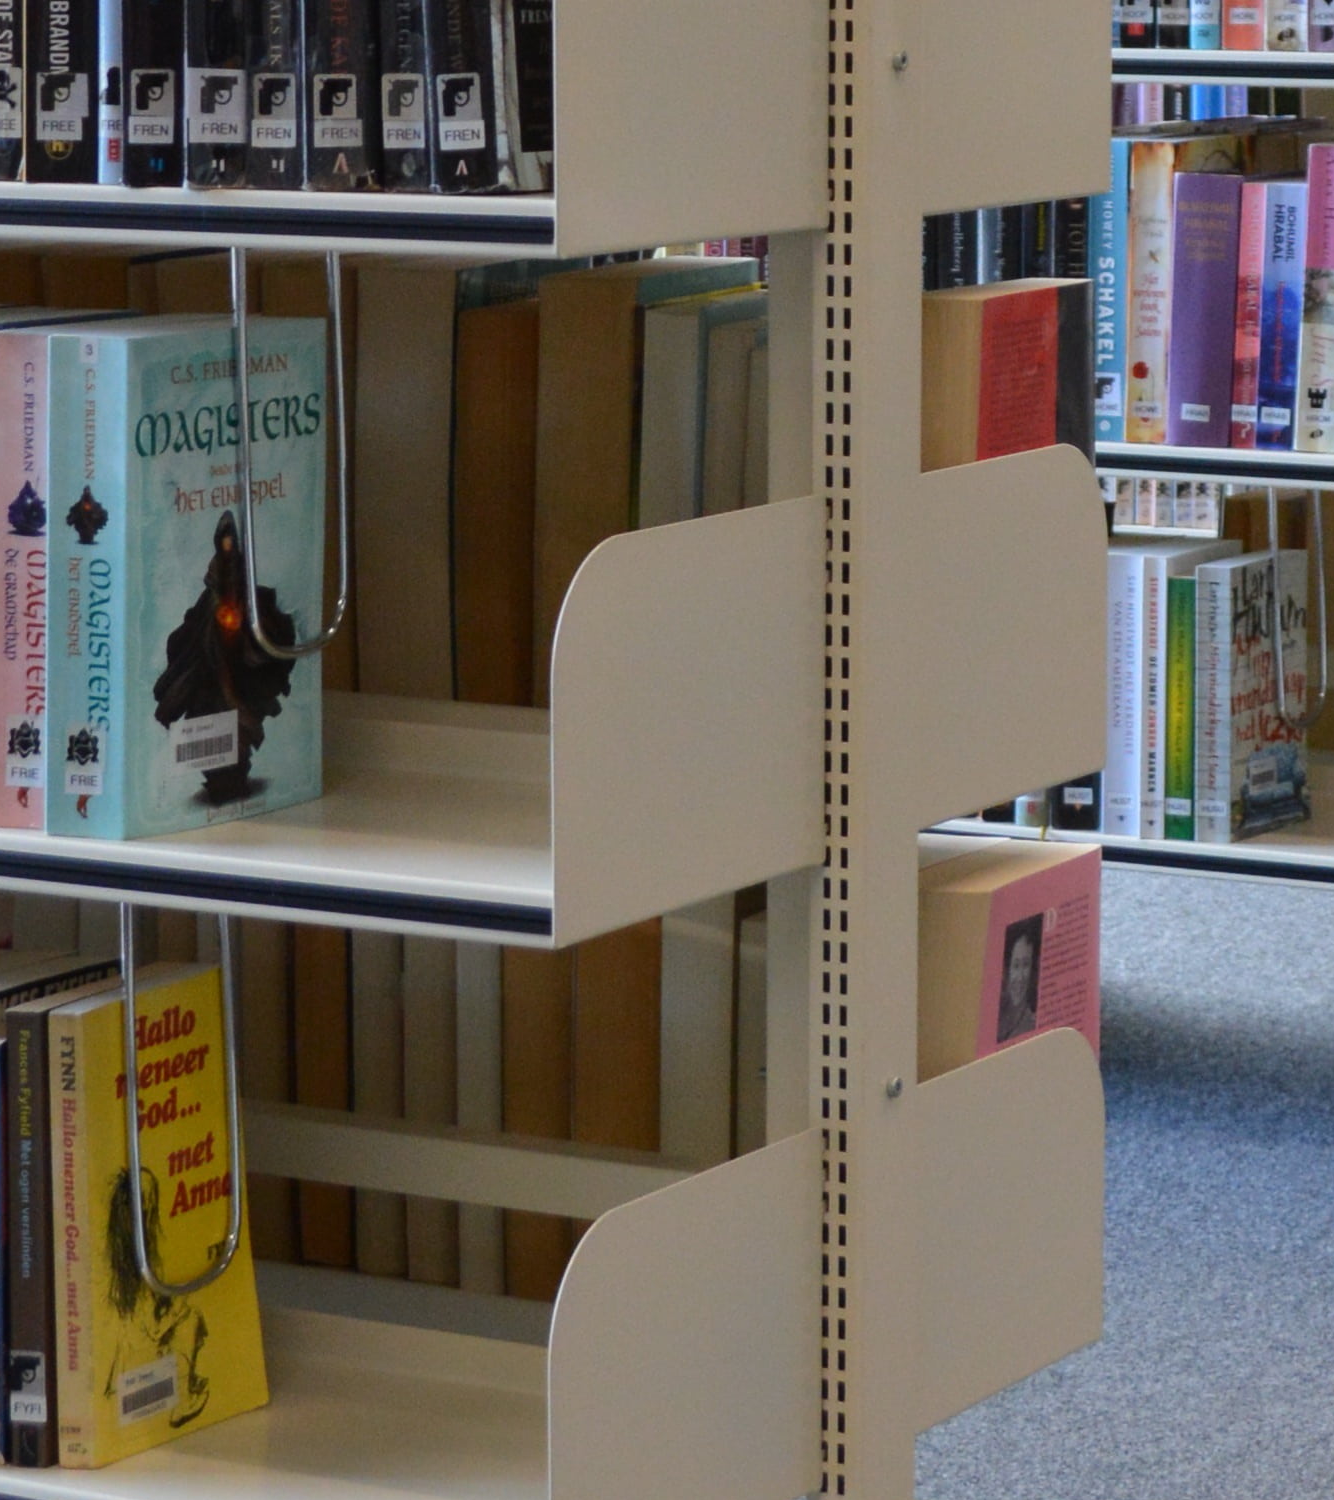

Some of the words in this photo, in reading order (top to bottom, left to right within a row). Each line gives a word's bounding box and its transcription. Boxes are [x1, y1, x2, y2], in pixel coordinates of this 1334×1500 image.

[43, 119, 76, 132] FREE
[201, 124, 238, 135] FREN
[1272, 204, 1285, 262] HRABAL
[1286, 206, 1296, 262] BOHUMIL
[1098, 257, 1115, 364] SCHAKEL
[70, 775, 99, 788] FRIE
[60, 1036, 75, 1091] FYNN
[168, 1133, 213, 1174] met
